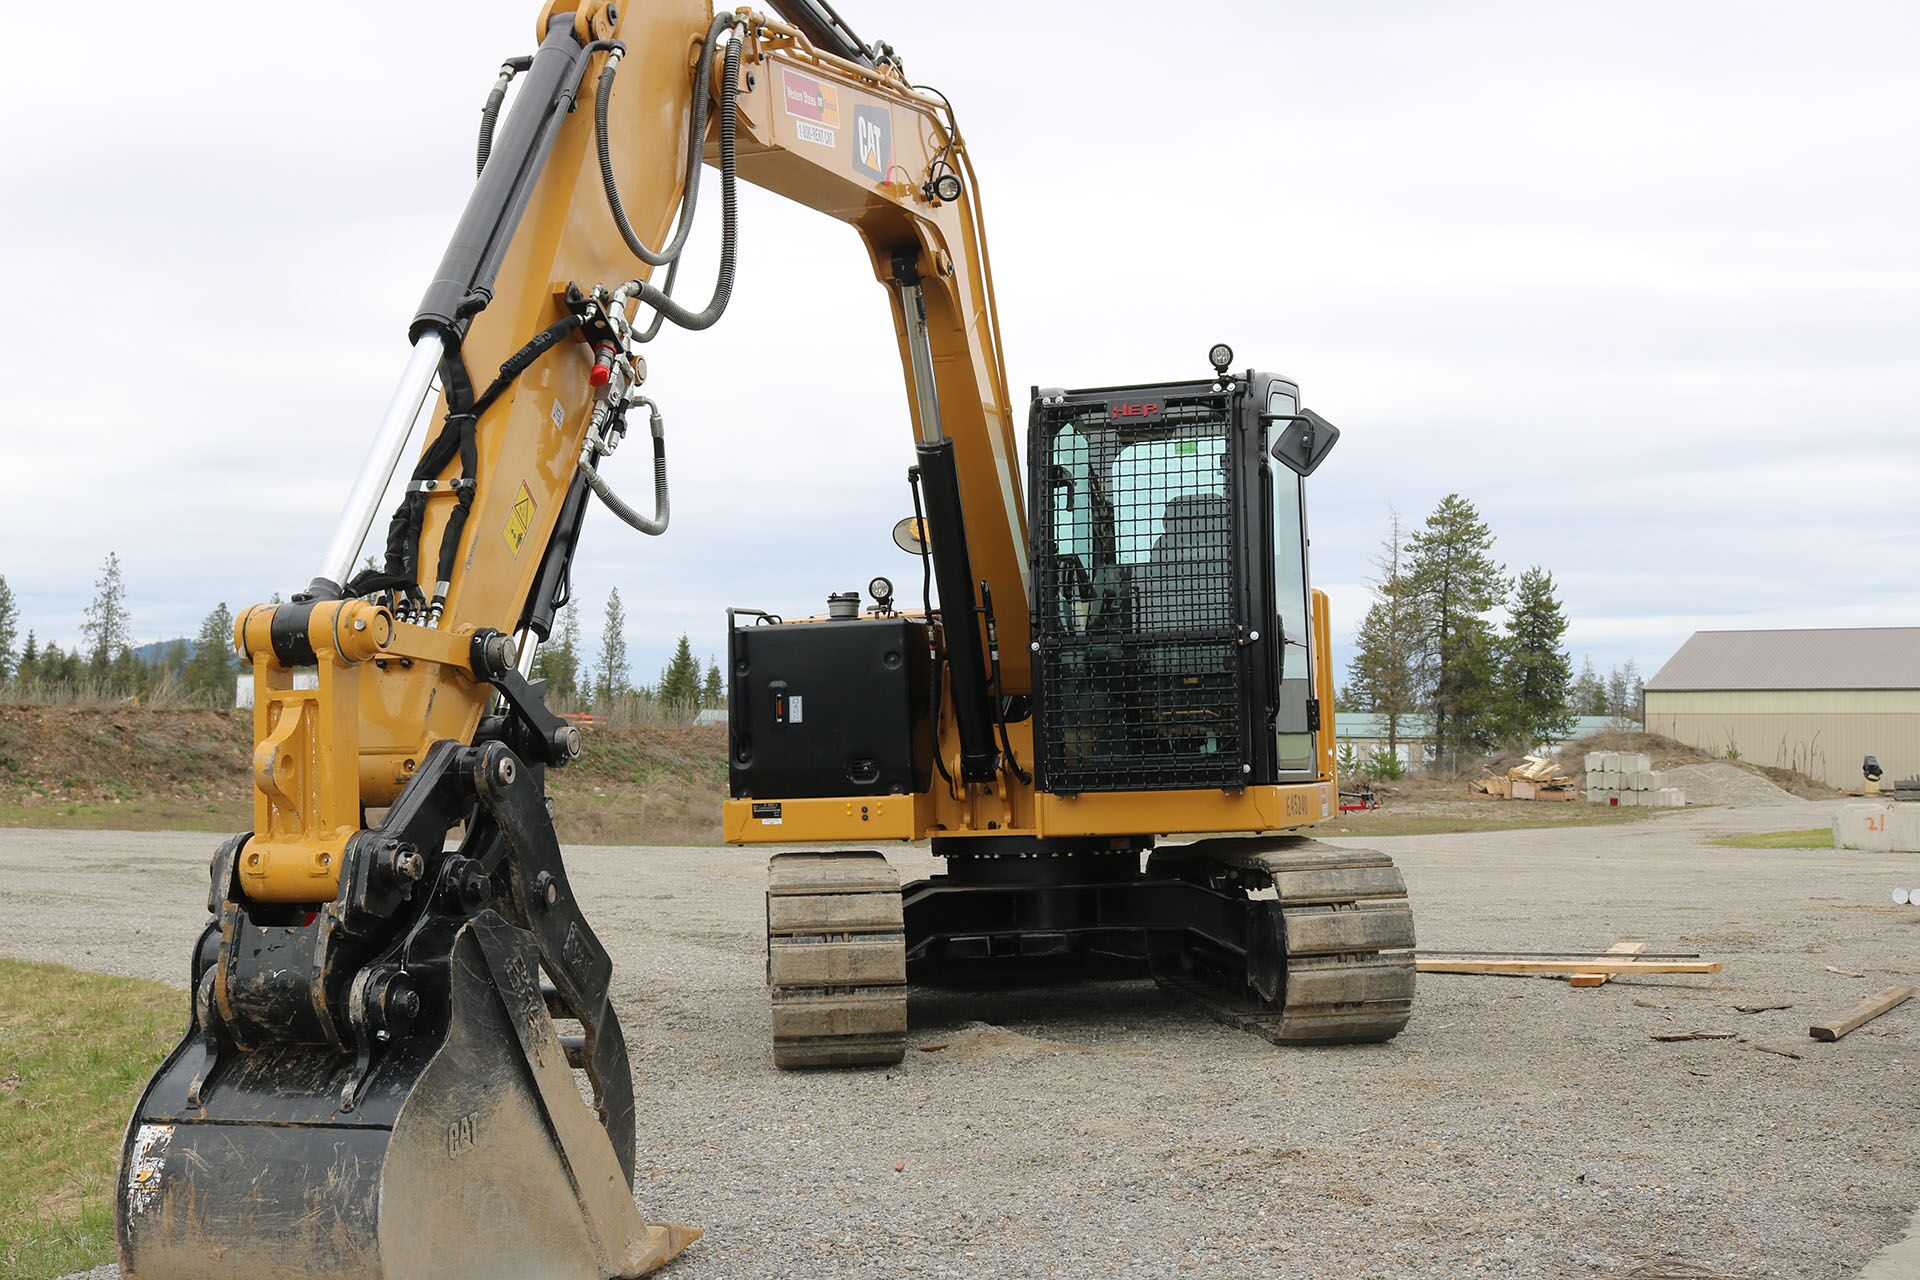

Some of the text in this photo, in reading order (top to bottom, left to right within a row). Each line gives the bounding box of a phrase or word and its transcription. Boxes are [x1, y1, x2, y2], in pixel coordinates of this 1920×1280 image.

[858, 115, 882, 172] CAT
[1864, 814, 1885, 832] 21
[448, 1111, 479, 1160] CAT
